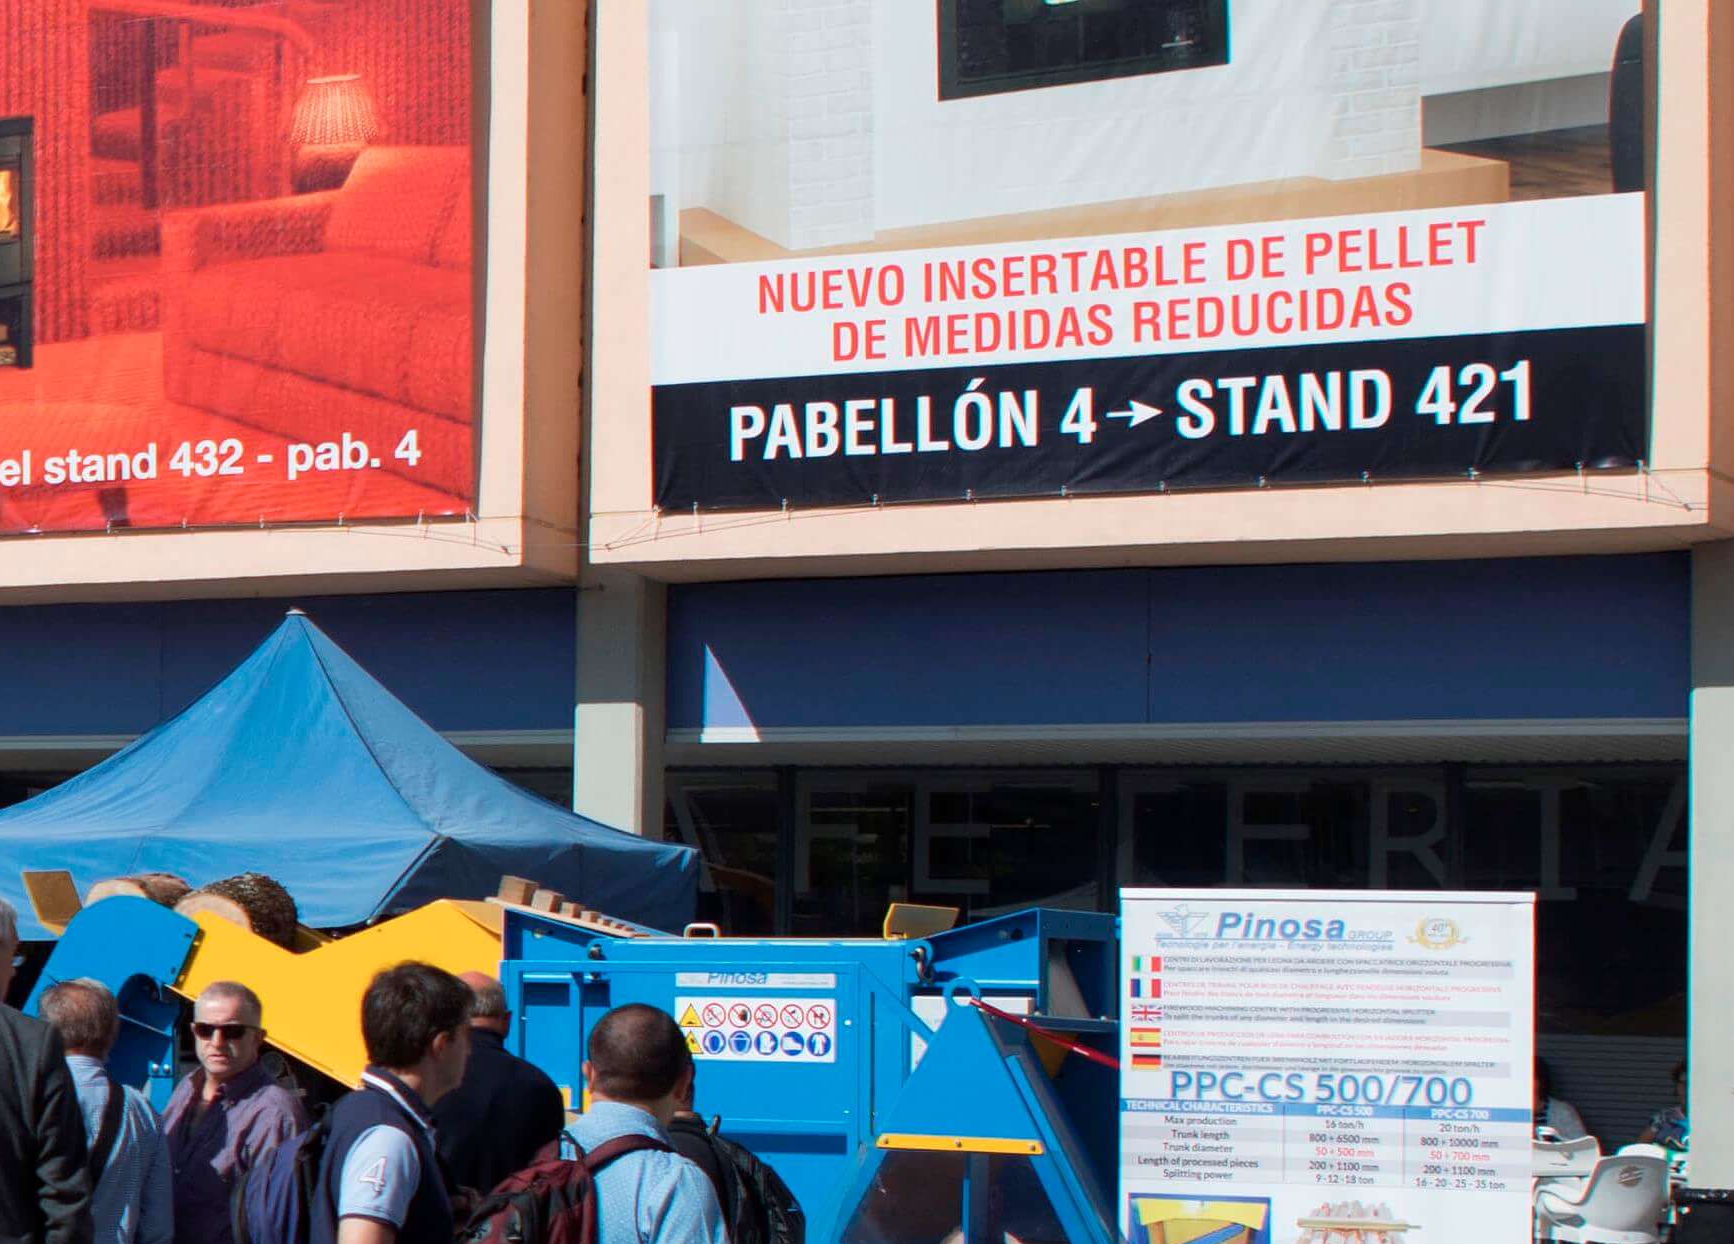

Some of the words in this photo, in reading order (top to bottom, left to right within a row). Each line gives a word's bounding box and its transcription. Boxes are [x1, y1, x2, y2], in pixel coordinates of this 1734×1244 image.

[758, 263, 906, 314] NUEVO
[923, 242, 1208, 303] INSERTABLE
[1226, 236, 1287, 281] DE
[1304, 219, 1487, 275] PELLET
[831, 320, 889, 362] DE
[904, 302, 1115, 359] MEDIDAS
[1133, 281, 1415, 344] REDUCIDAS
[730, 378, 1040, 462] PABELLÓN
[1060, 387, 1097, 444] 4
[1176, 367, 1393, 441] STAND
[1415, 359, 1534, 427] 421
[43, 443, 158, 485] stand
[168, 437, 245, 476] 432
[287, 432, 382, 479] pab.
[393, 429, 422, 467] 4
[1215, 911, 1346, 940] Pinosa
[1348, 930, 1393, 940] GROUP
[1172, 1071, 1305, 1101] PPC-CS
[1315, 1074, 1473, 1108] 500/700
[359, 1156, 388, 1198] 4
